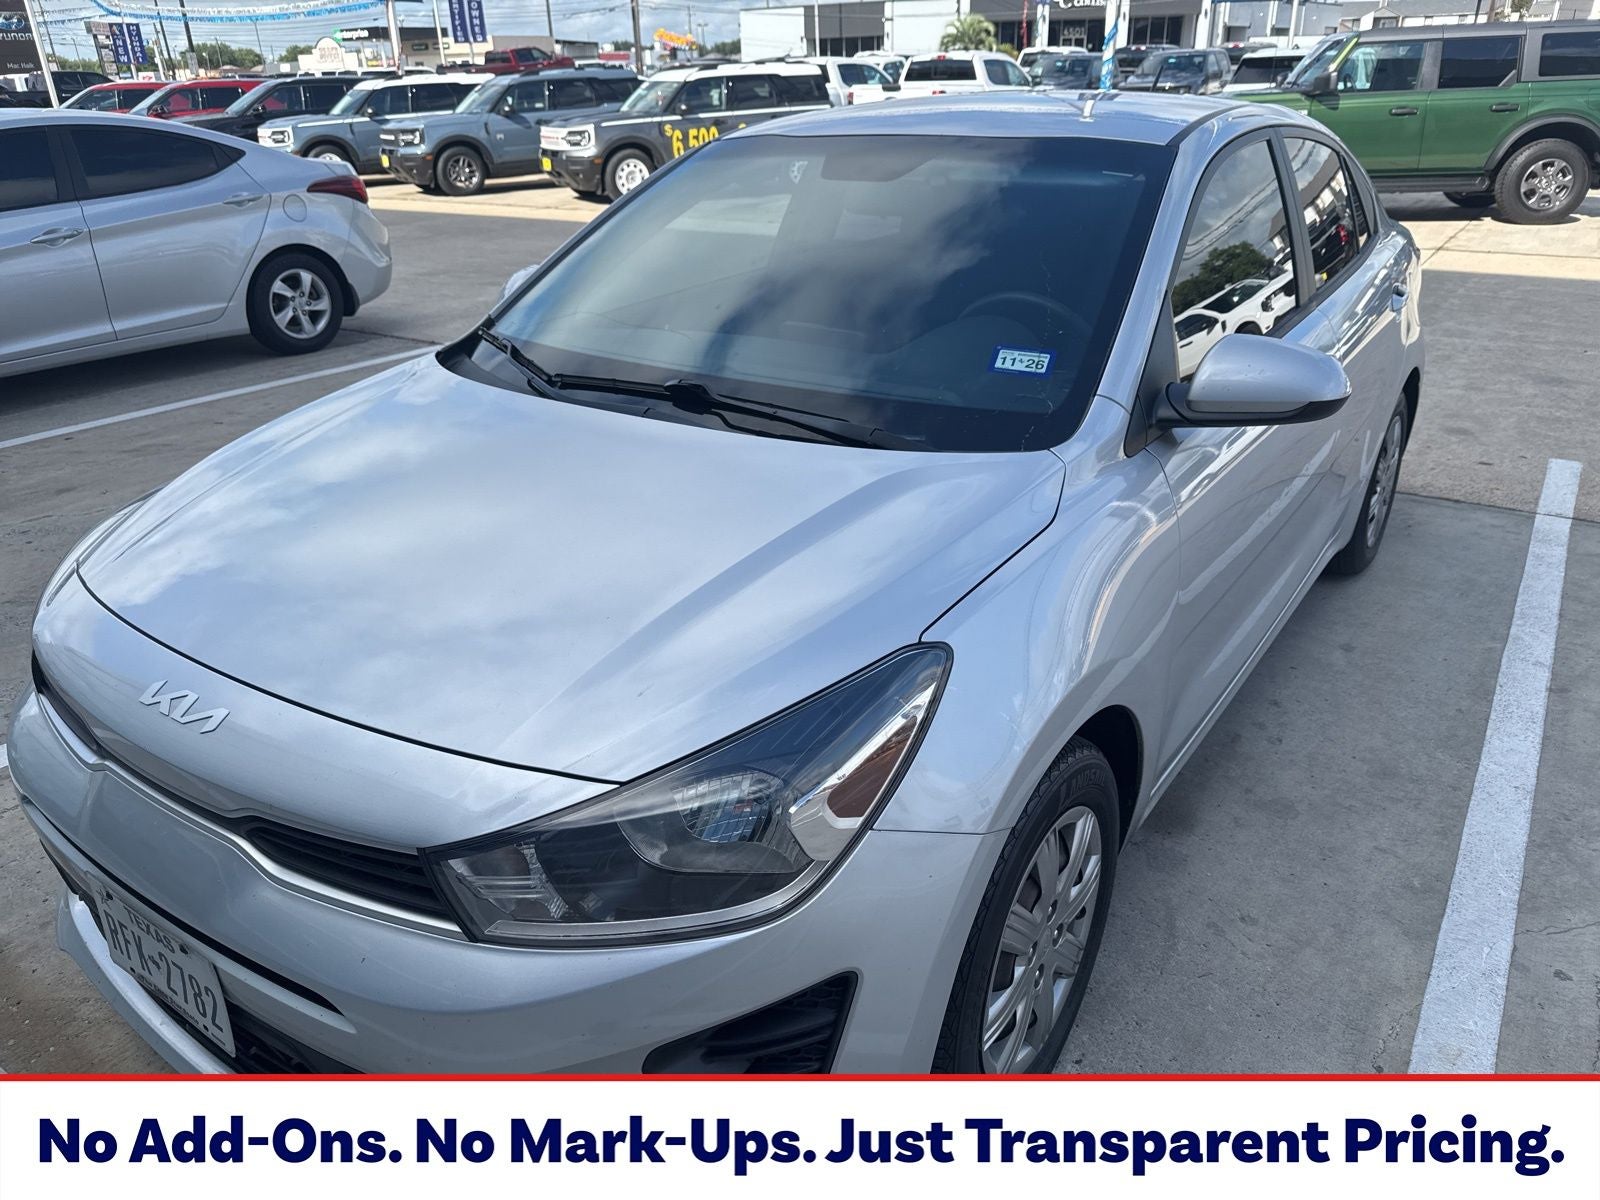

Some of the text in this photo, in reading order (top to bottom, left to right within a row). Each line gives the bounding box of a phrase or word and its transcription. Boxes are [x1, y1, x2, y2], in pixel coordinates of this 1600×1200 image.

[470, 1, 484, 42] OWNED
[115, 38, 128, 63] NEW
[129, 24, 143, 63] HYUNDAI
[999, 356, 1046, 370] 11 26
[139, 680, 230, 734] KIA
[122, 904, 176, 954] TEXAS
